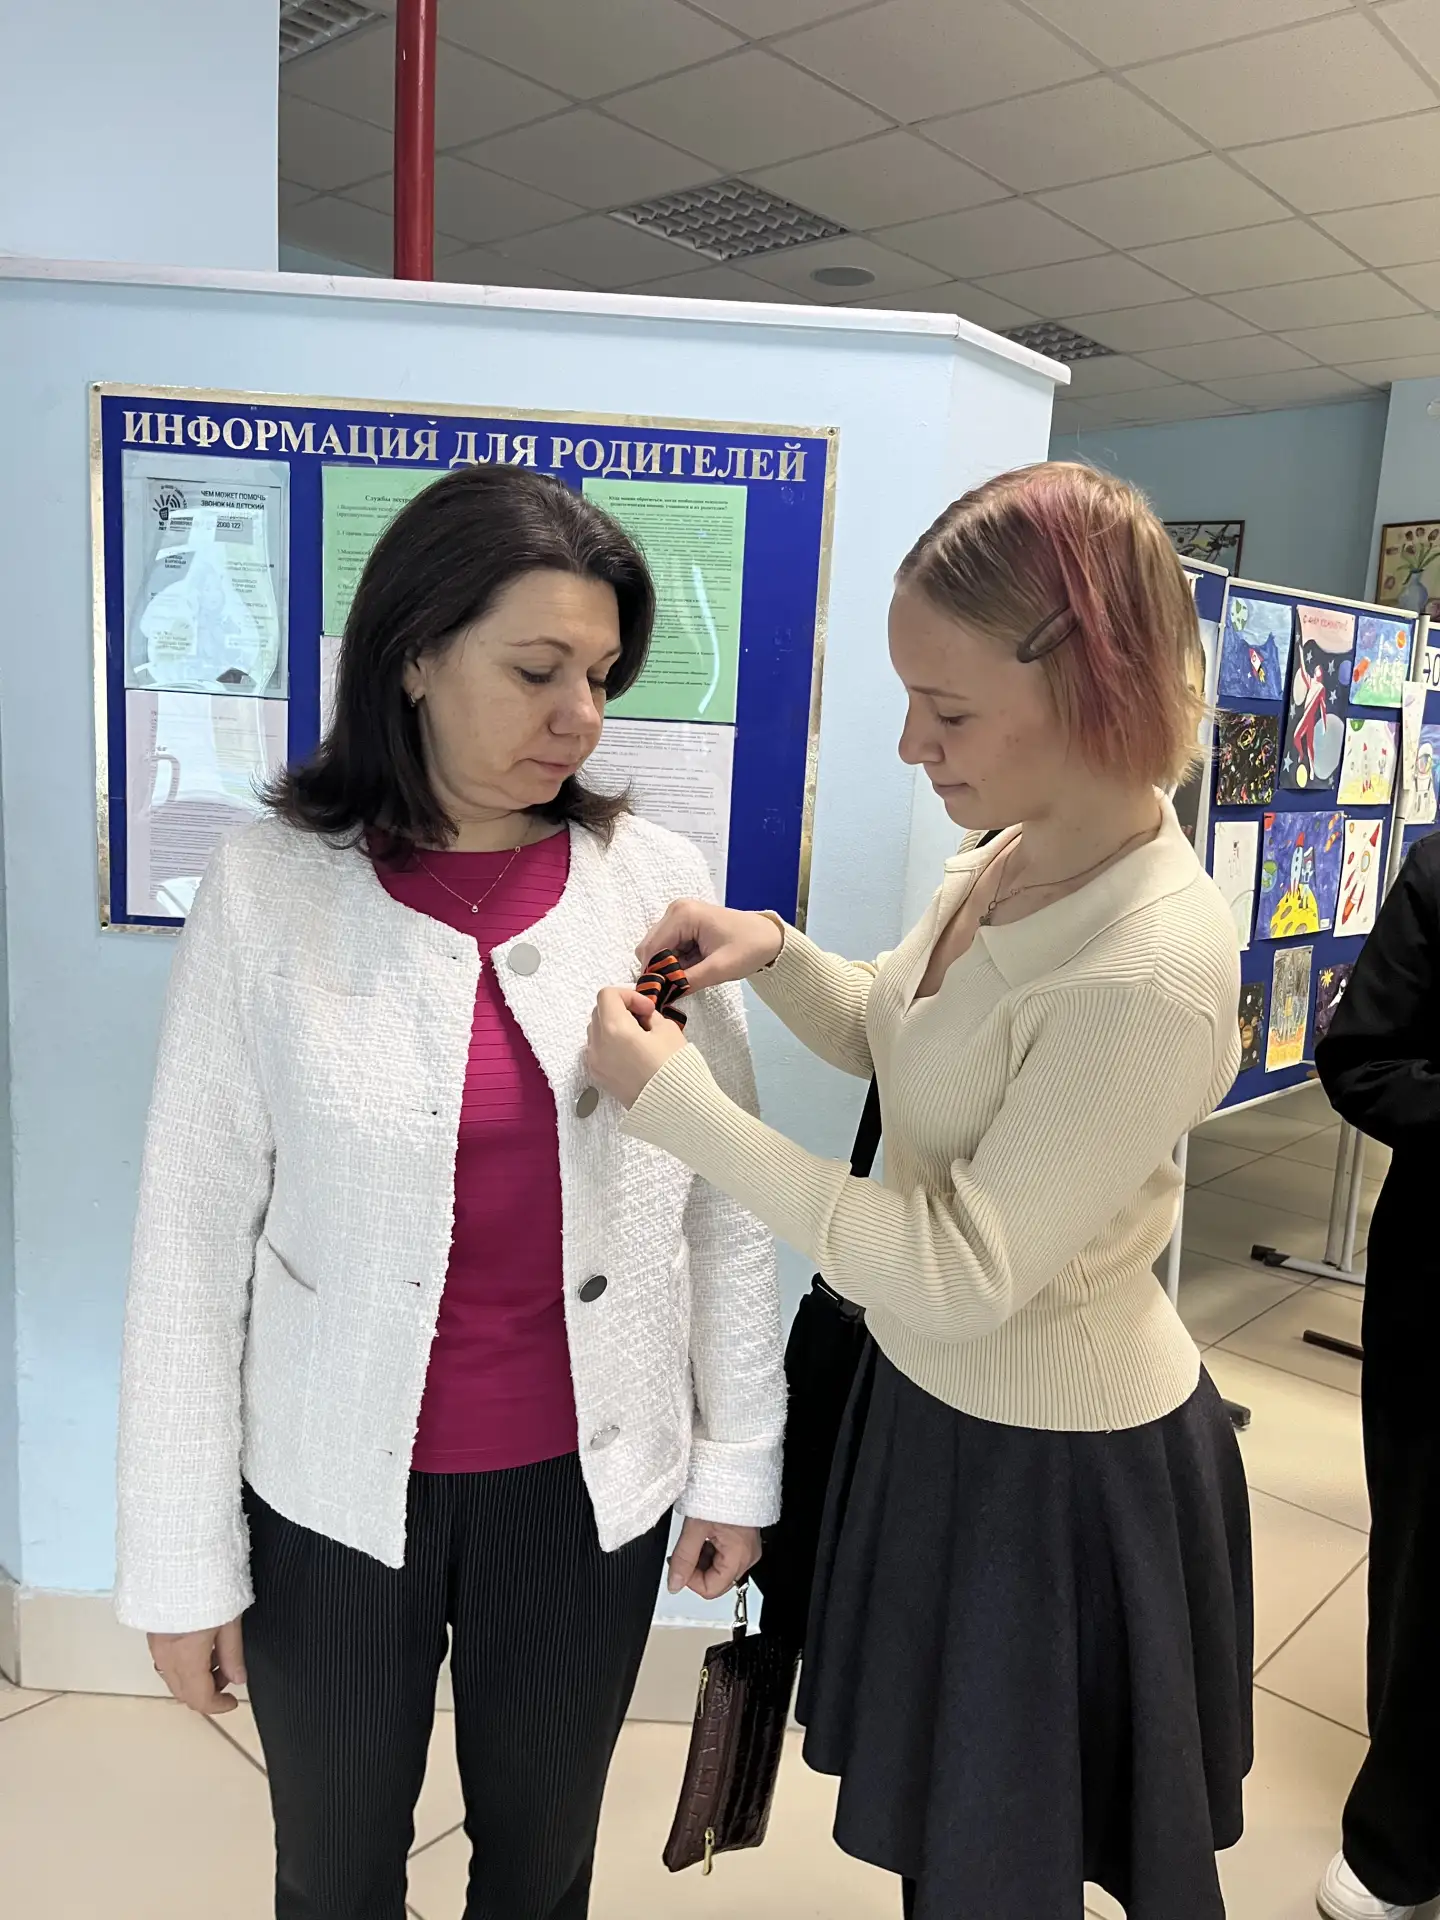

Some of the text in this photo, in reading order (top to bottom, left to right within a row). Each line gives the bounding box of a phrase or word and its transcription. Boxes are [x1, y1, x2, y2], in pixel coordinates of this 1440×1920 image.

[122, 411, 808, 482] ИНФОРМАЦИЯ ДЛЯ РОДИТЕЛЕЙ
[215, 491, 238, 499] МОЖЕТ
[239, 493, 266, 501] ПОМОЧЬ
[200, 500, 225, 508] ЗВОНОК
[236, 502, 265, 510] ДЕТСКИЙ
